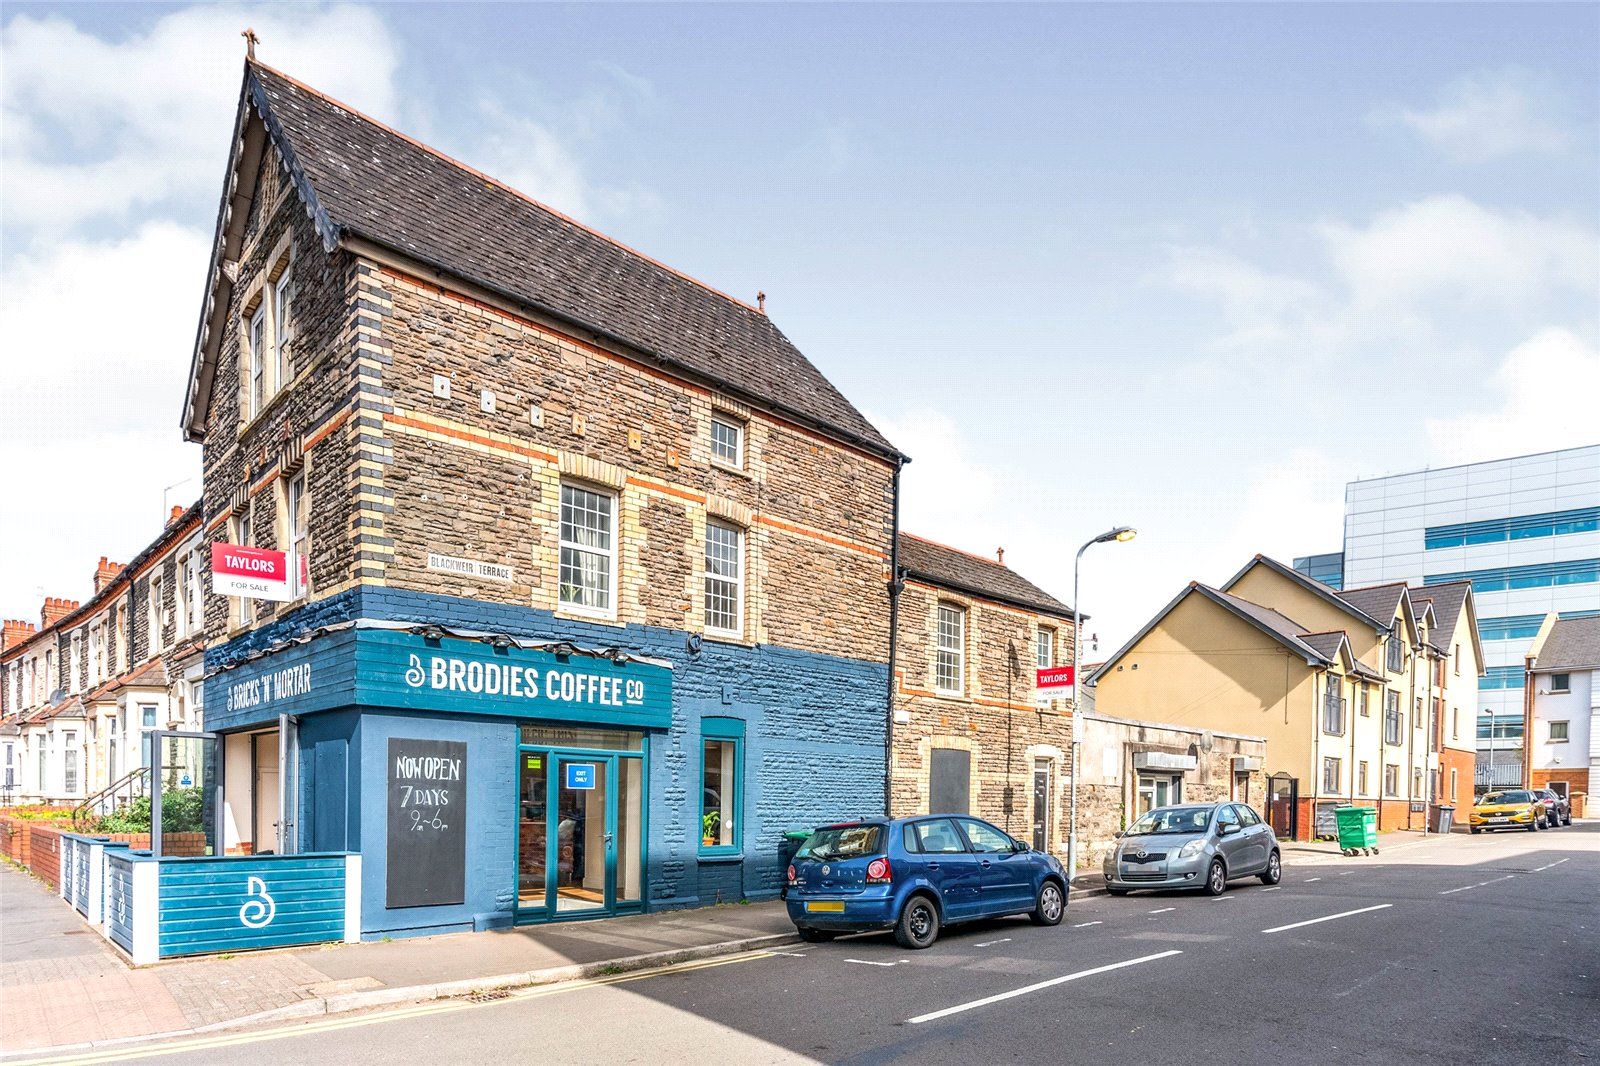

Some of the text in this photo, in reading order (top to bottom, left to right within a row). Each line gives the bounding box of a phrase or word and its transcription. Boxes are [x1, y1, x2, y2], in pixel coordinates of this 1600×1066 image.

[224, 555, 275, 573] TAYLORS
[431, 556, 509, 579] BLACKWEIR TERRACE
[250, 584, 269, 592] SALE
[234, 678, 260, 711] BRICKS
[274, 662, 311, 700] MORTAR
[431, 657, 539, 699] BRODIES
[546, 669, 623, 706] COFFEE
[626, 679, 644, 702] CO
[1040, 674, 1068, 684] TAYLORS
[396, 755, 461, 781] NOW OPEN
[400, 785, 449, 808] 7 DAYS
